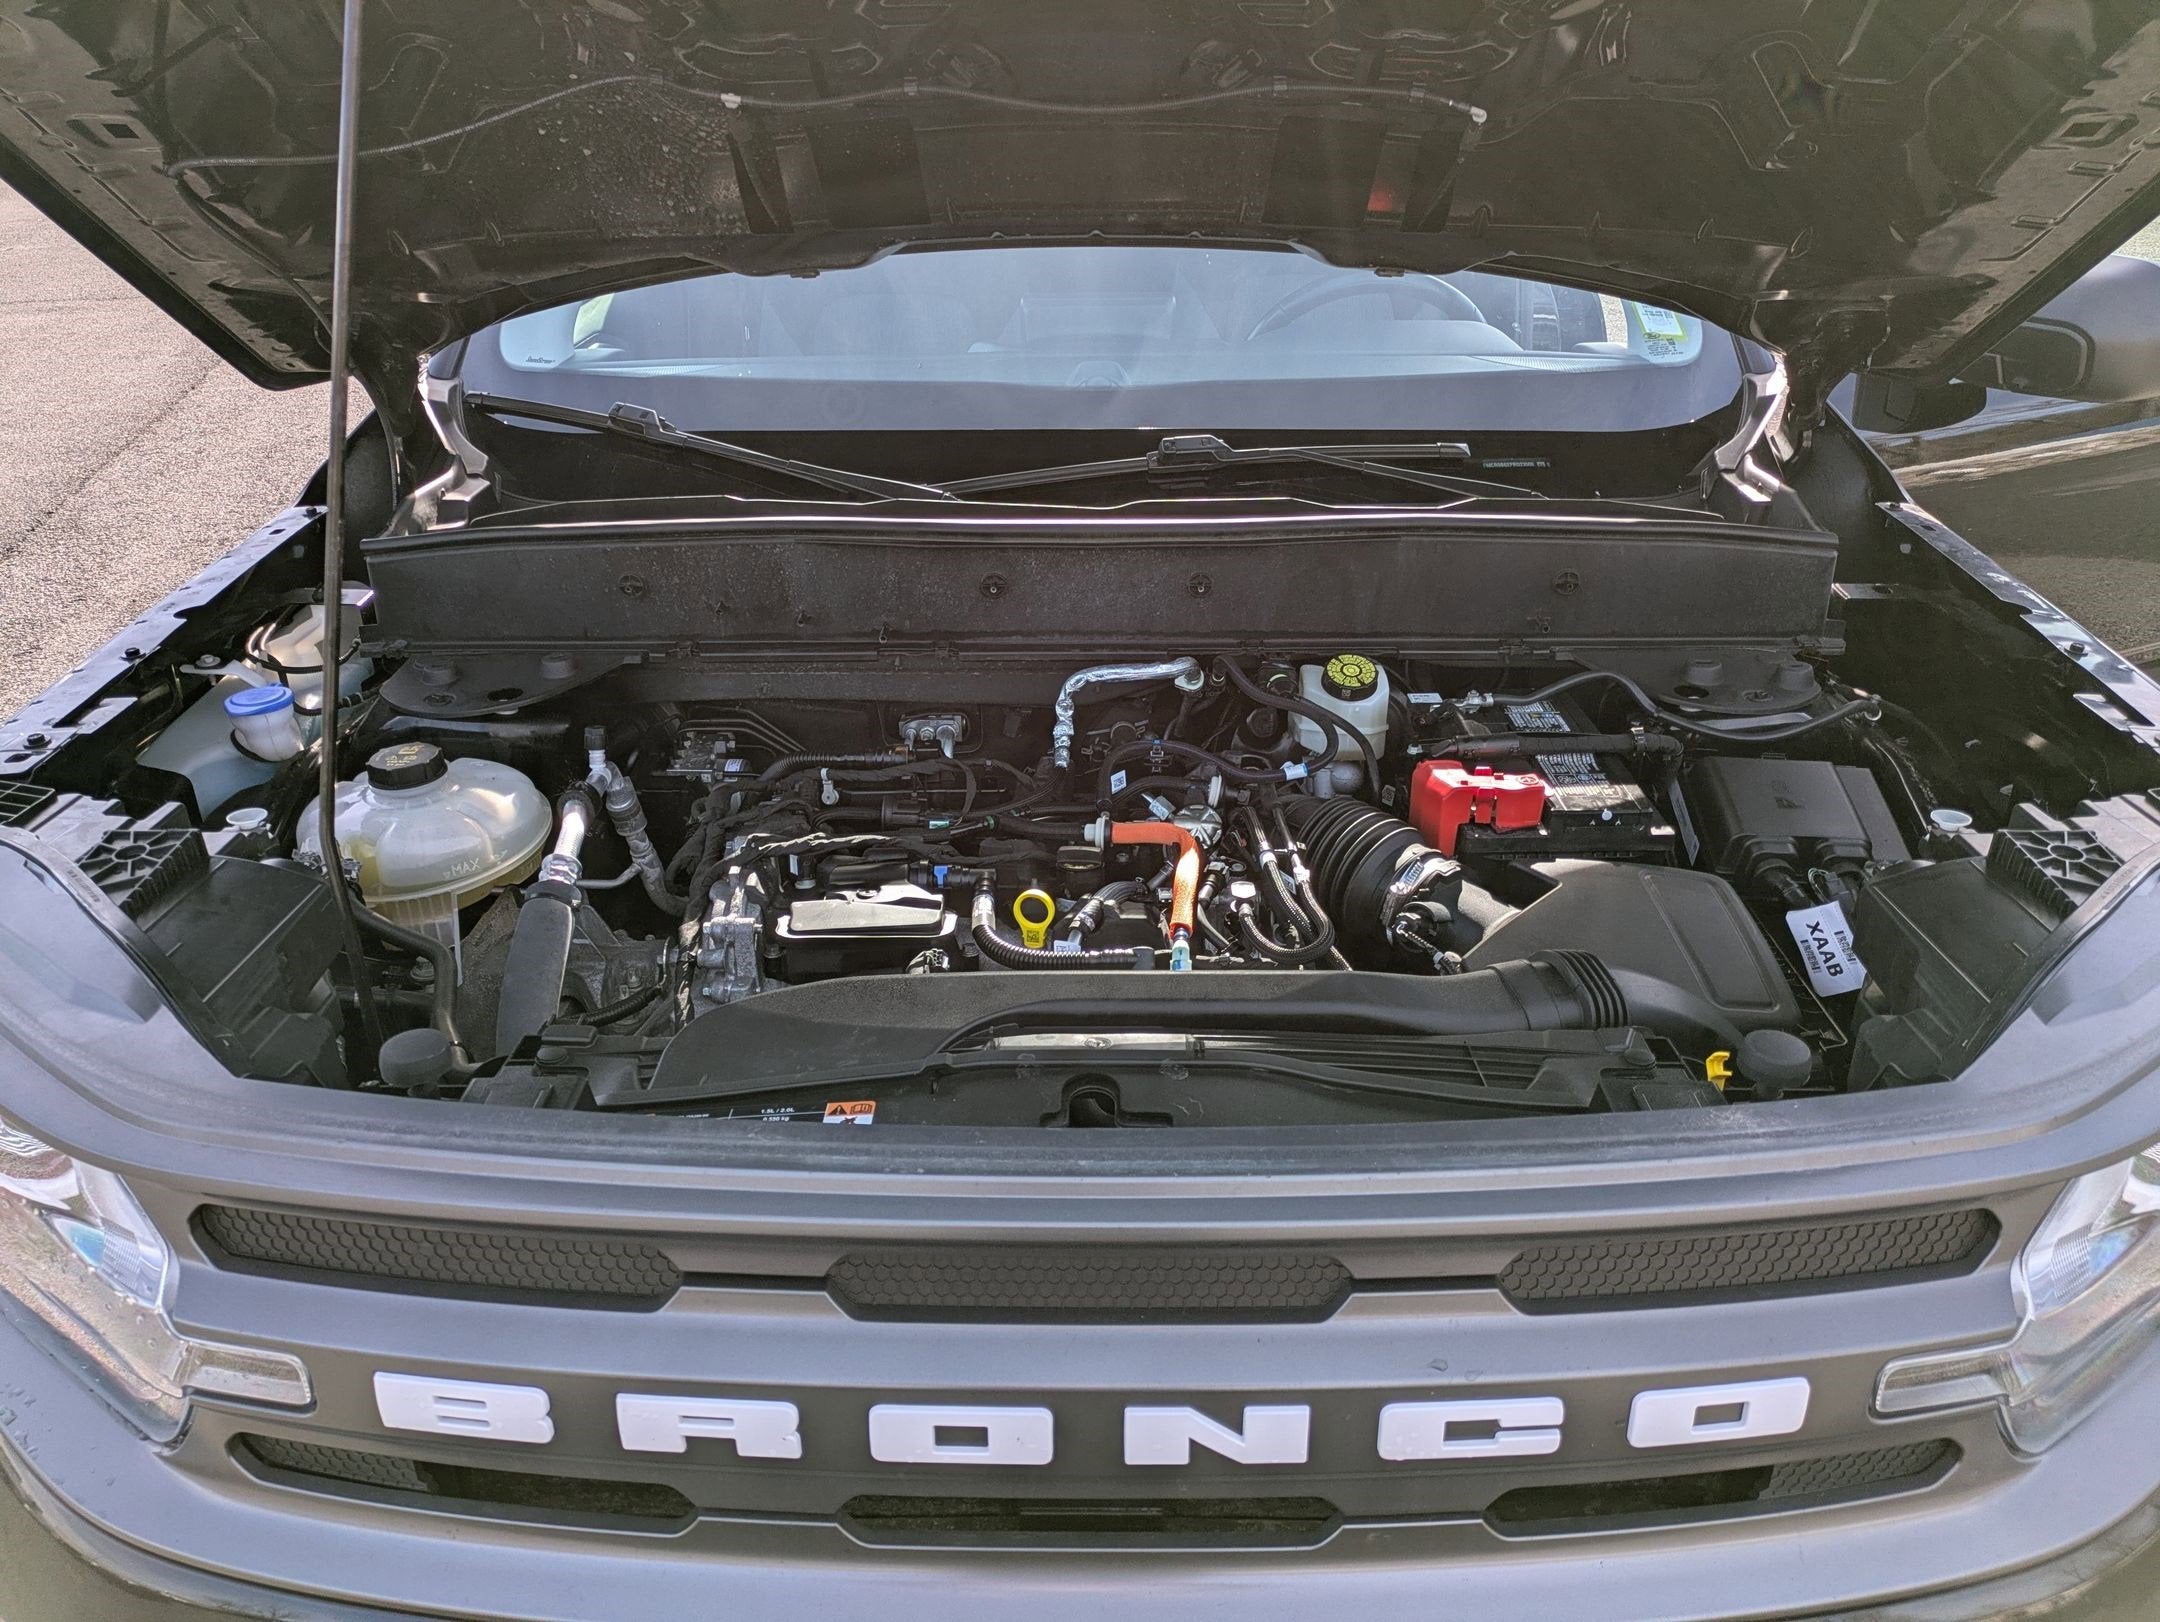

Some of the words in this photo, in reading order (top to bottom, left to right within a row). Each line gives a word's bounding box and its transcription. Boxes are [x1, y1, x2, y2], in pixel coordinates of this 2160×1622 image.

[451, 857, 480, 877] MAX
[1805, 920, 1844, 977] XAAB
[373, 1371, 1811, 1466] BRONCO
